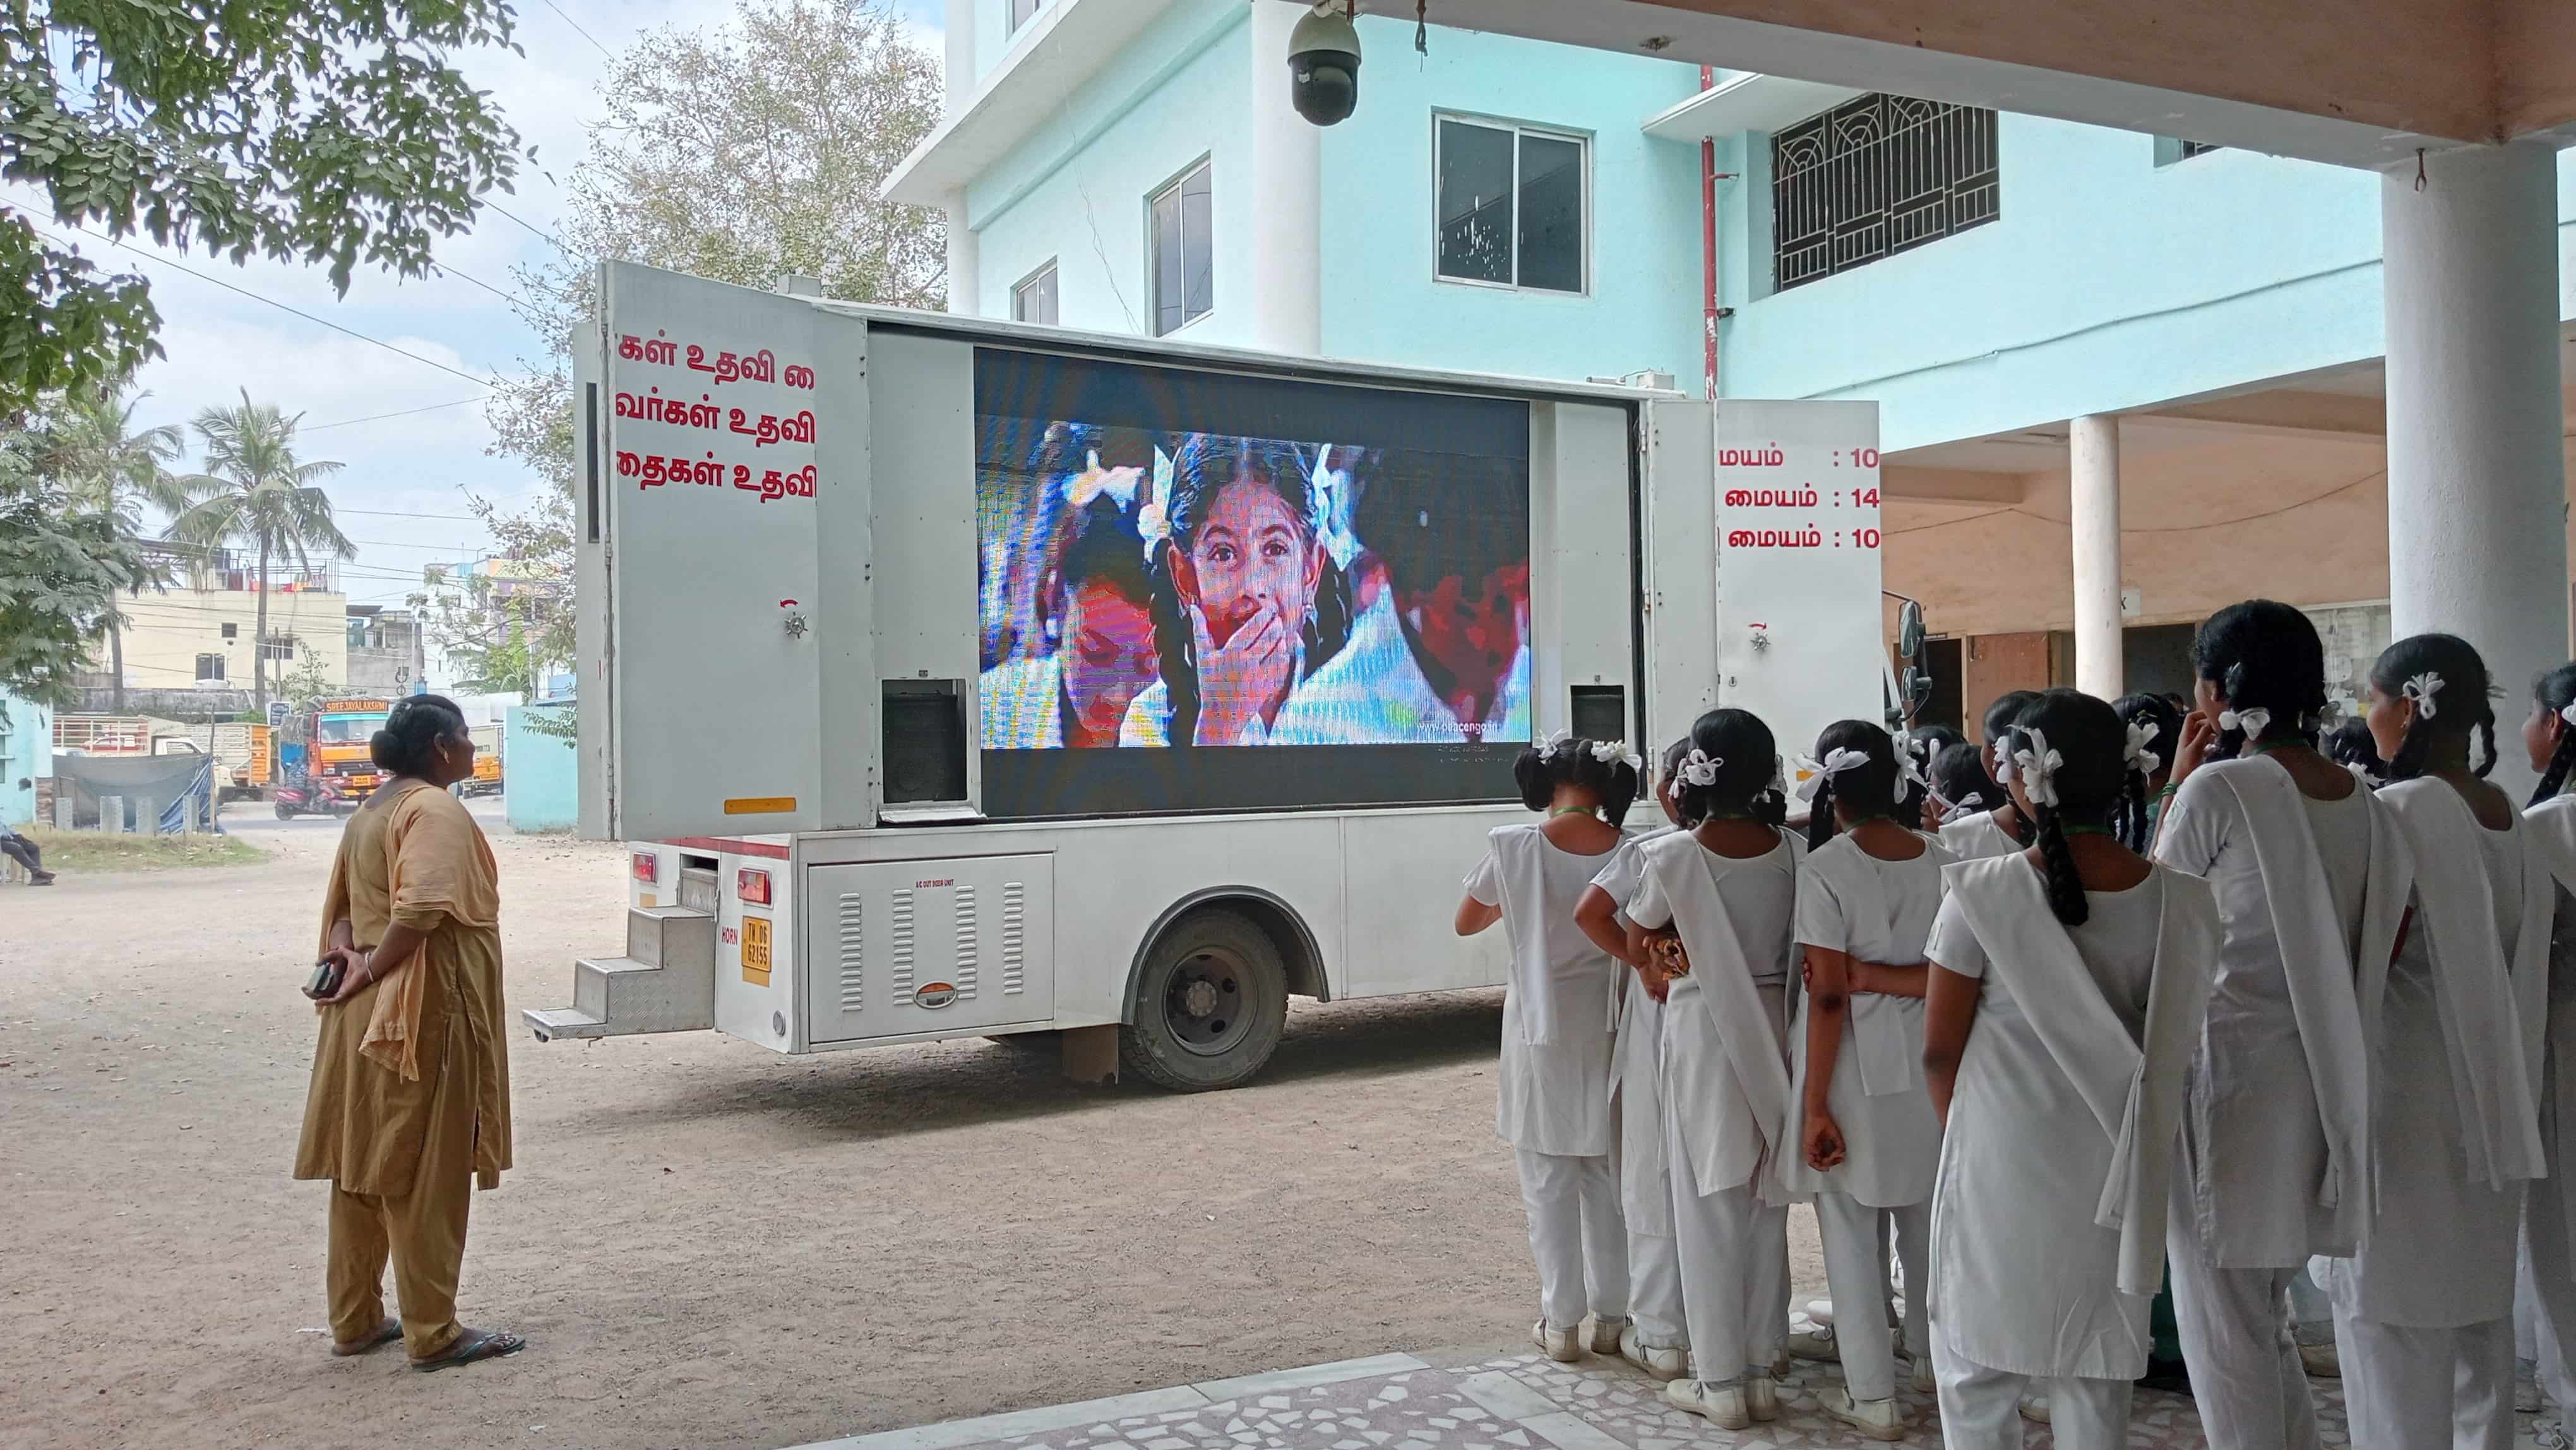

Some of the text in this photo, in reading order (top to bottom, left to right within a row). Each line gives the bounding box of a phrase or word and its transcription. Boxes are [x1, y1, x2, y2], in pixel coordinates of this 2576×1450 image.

[615, 328, 677, 366] கள்
[686, 345, 775, 385] உதவி
[616, 386, 816, 447] வர்கள் உதவி
[1719, 441, 1784, 467] மயம்
[1850, 448, 1880, 468] 10
[732, 465, 818, 503] உதவி
[1724, 482, 1818, 507] மையம்
[1851, 488, 1880, 508] 14
[1727, 522, 1822, 548] மையம்
[1851, 528, 1880, 549] 10
[722, 926, 738, 945] HORN
[748, 922, 756, 942] TN
